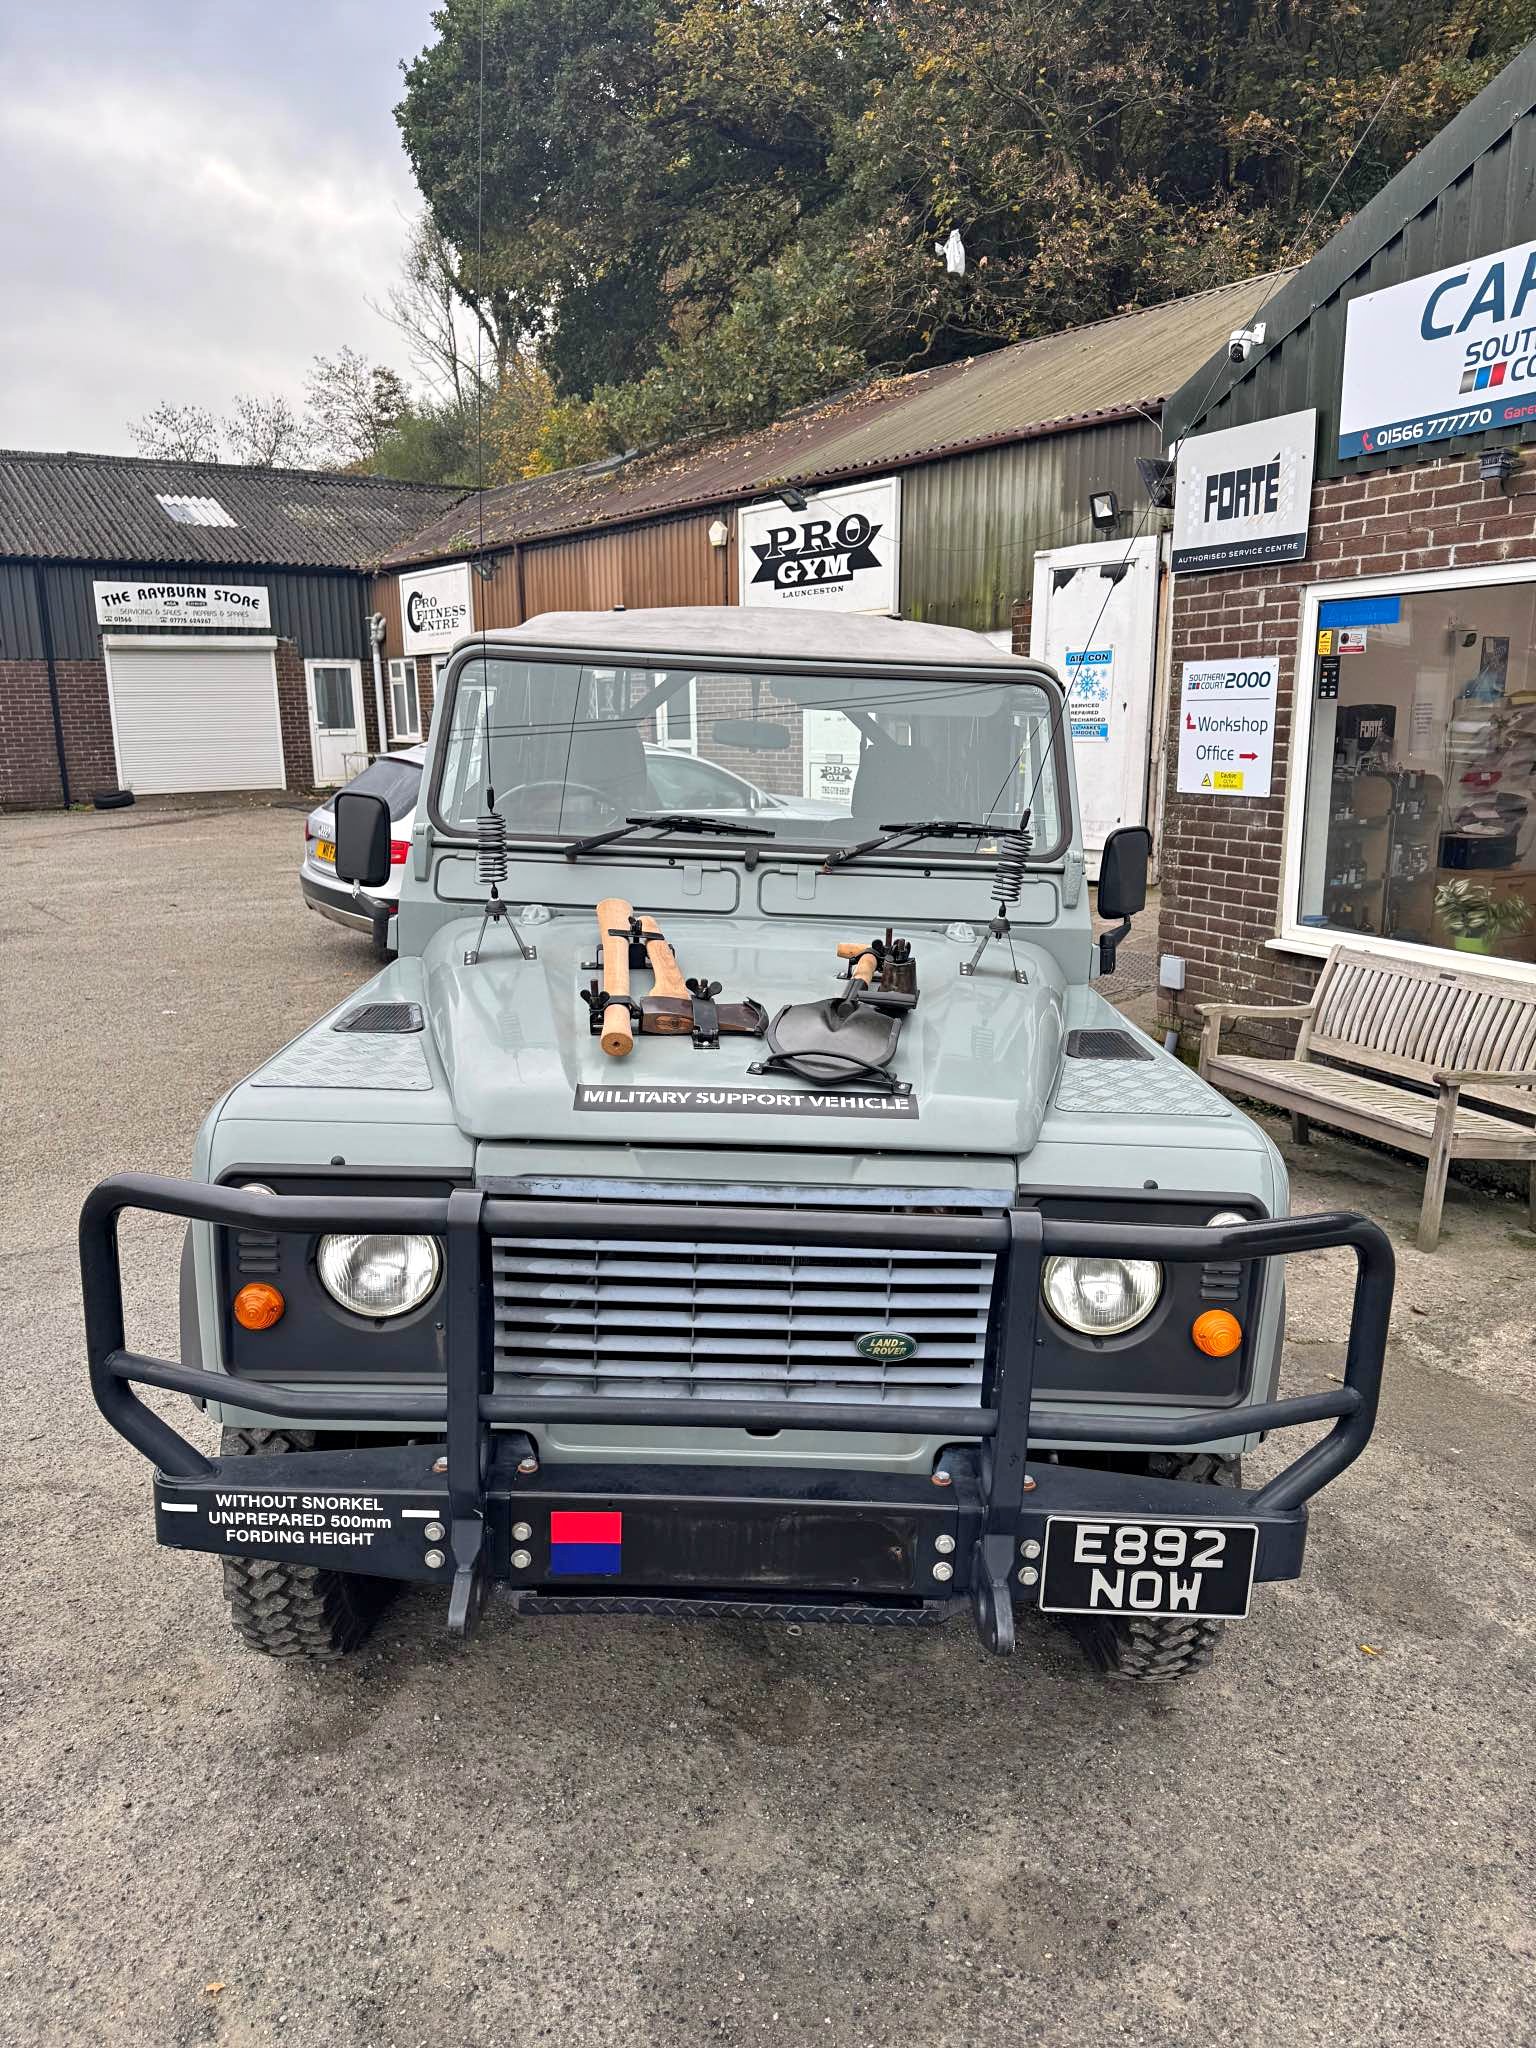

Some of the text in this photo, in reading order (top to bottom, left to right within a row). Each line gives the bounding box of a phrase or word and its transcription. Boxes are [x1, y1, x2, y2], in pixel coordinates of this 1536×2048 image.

[1464, 326, 1536, 367] SOUT
[1504, 404, 1536, 420] Gare
[1377, 408, 1492, 447] 01566 777770
[1204, 452, 1281, 523] FORTÉ
[765, 513, 871, 560] PRO
[1178, 542, 1299, 564] AUTHORISED SERVICE CENTRE
[777, 552, 853, 584] GYM
[101, 586, 261, 610] THE RAYBURN STORE
[782, 585, 845, 599] LAUNCESTON
[414, 597, 438, 610] PRO
[416, 604, 467, 621] FITNESS
[1088, 653, 1109, 662] CON
[1189, 672, 1226, 682] SOUTHERN
[1201, 681, 1225, 690] COURT
[1225, 671, 1271, 689] 2000
[1198, 716, 1268, 736] Workshop
[1196, 744, 1235, 761] Office
[583, 1090, 909, 1110] MILITARY SUPPORT VEHICLE
[870, 1338, 899, 1347] LAND
[871, 1347, 907, 1355] ROVER
[215, 1494, 384, 1511] WITHOUT SNORKEL
[208, 1511, 392, 1528] UNPREPARED 500mm
[226, 1529, 375, 1546] FORDING HEIGHT
[1073, 1523, 1227, 1569] E892
[1089, 1568, 1203, 1611] NOW
